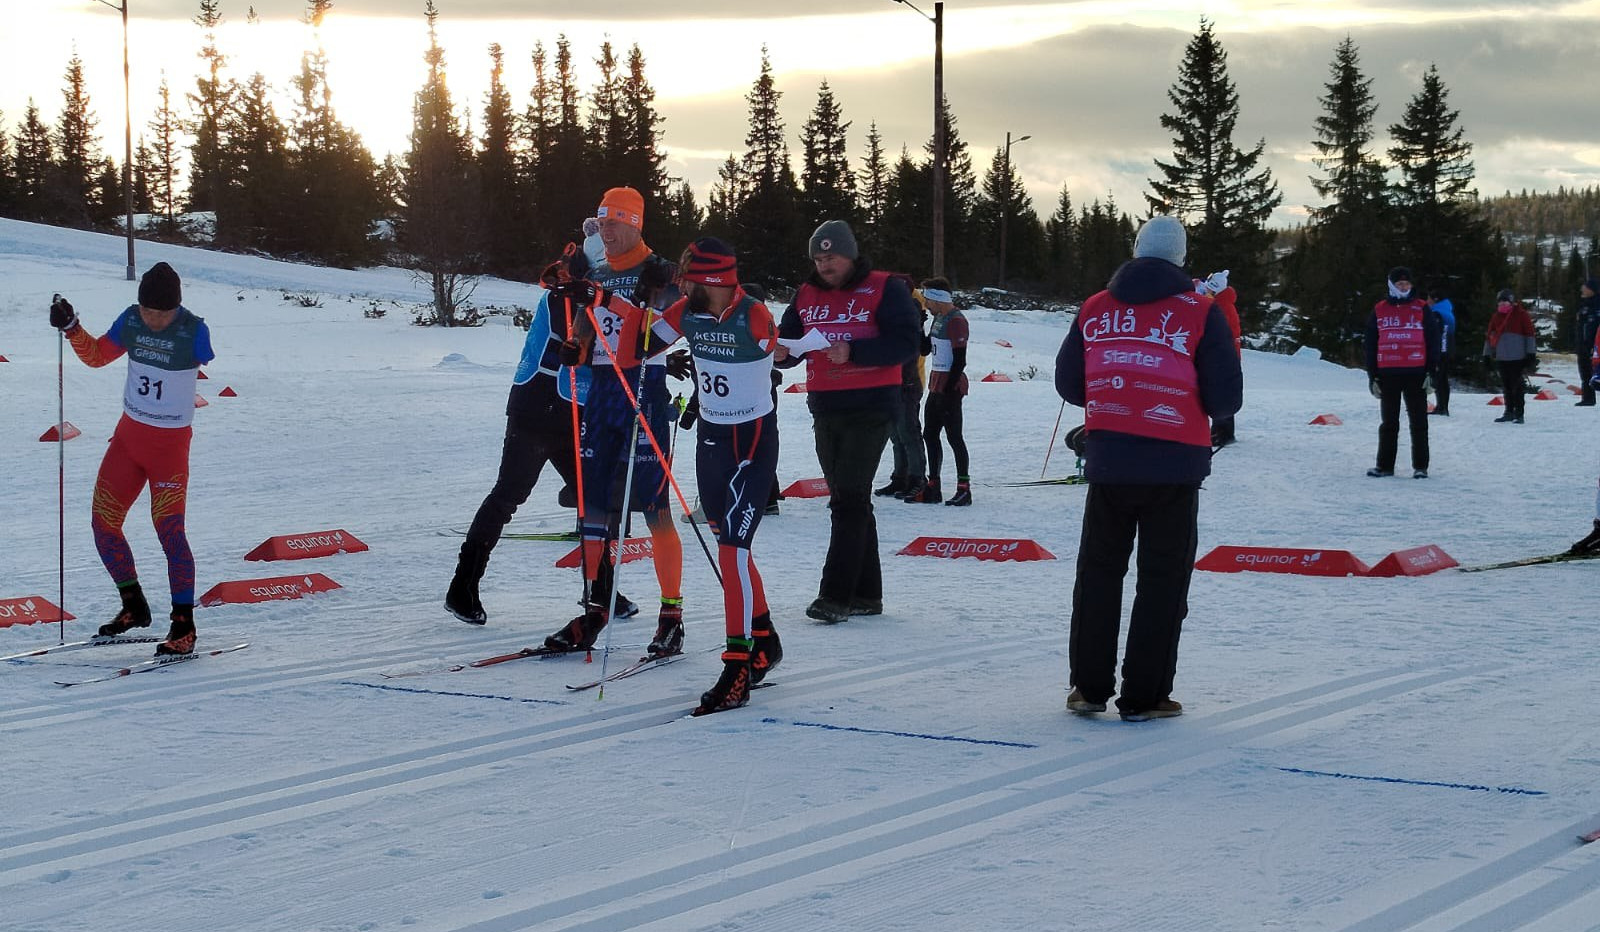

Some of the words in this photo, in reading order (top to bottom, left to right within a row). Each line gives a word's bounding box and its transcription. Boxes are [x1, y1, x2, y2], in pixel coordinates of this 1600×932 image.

[602, 276, 639, 287] MESTER
[1083, 308, 1136, 342] Gålå
[135, 335, 175, 350] MESTER
[693, 332, 736, 343] MESTER
[134, 348, 170, 364] GRØNN
[694, 343, 735, 357] GRØNN
[1102, 350, 1163, 368] Starter
[138, 375, 163, 400] 31
[701, 371, 730, 398] 36
[738, 503, 756, 540] swix
[286, 535, 333, 551] equinor
[925, 540, 999, 556] equinor
[1235, 552, 1297, 564] equinor
[250, 583, 298, 599] equinor
